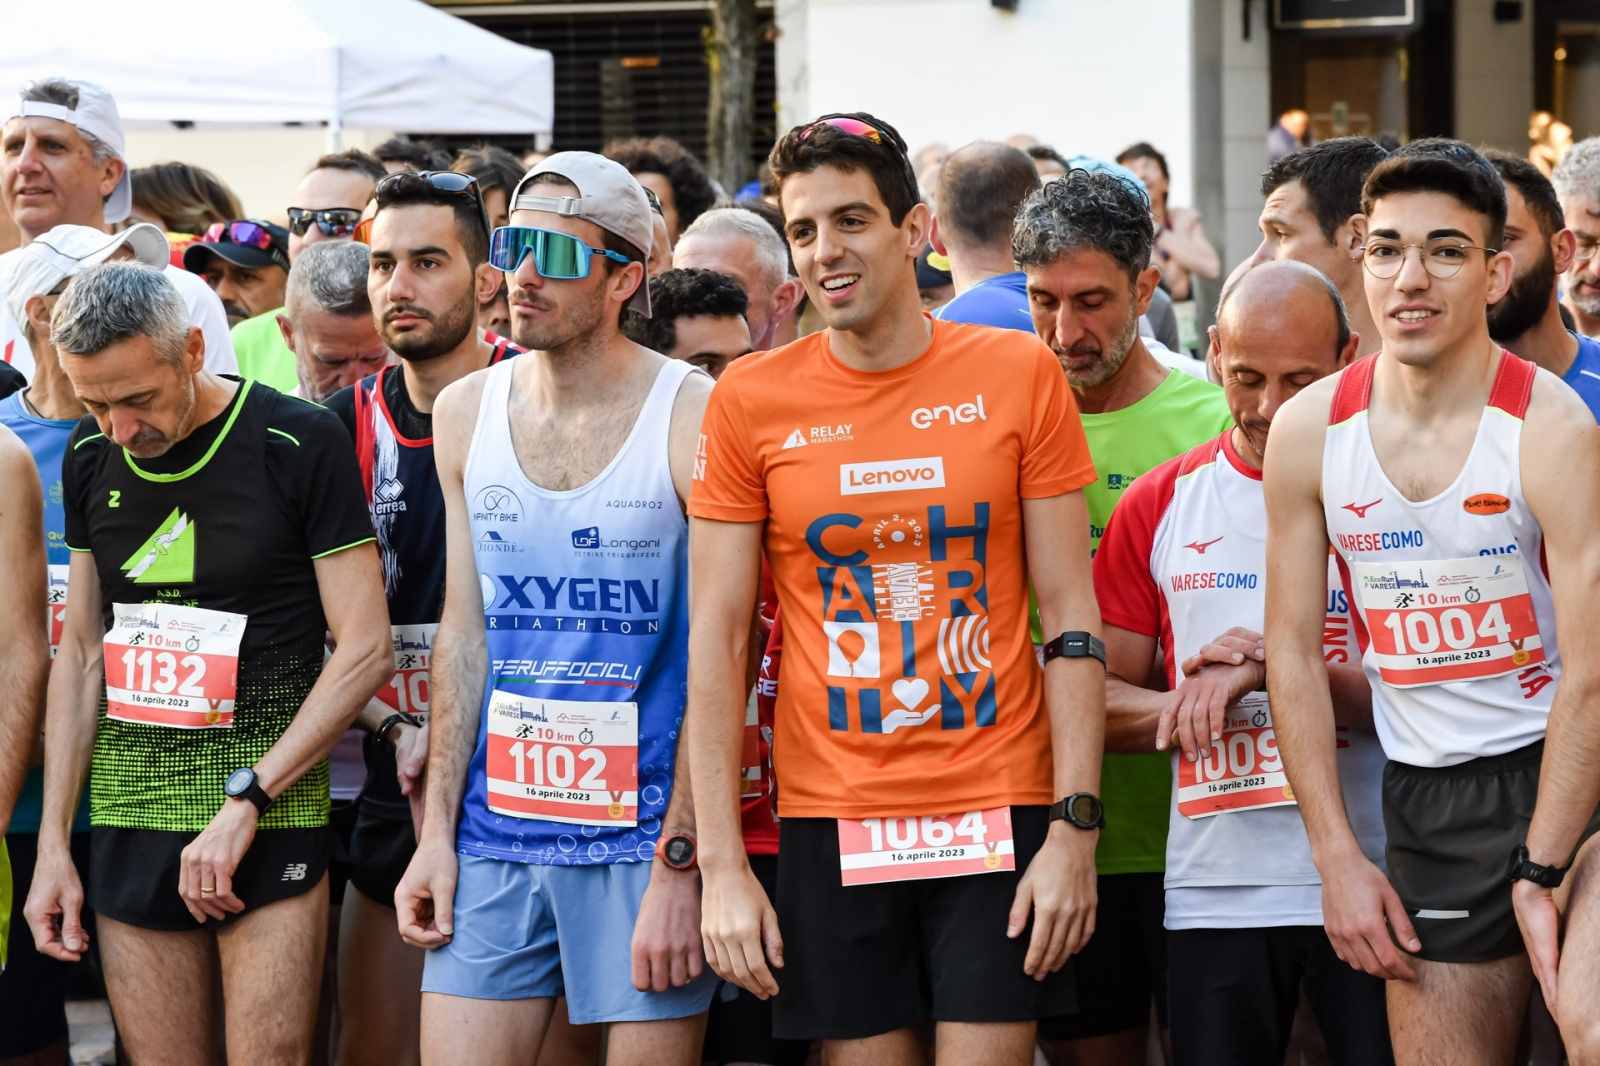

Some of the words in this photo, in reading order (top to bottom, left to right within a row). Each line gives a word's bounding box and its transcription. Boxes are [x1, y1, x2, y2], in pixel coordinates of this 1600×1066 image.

[911, 394, 987, 429] enel
[810, 424, 853, 438] RELAY
[810, 434, 854, 444] MARATHON
[849, 467, 935, 486] Lenovo
[376, 501, 407, 514] errea
[606, 500, 663, 509] AQUADRO2
[500, 513, 518, 522] BIKE
[873, 519, 889, 550] APRIL
[908, 519, 923, 547] 2023
[600, 538, 660, 550] Longoni
[1171, 572, 1258, 592] VARESECOMO
[157, 589, 182, 598] A.S.D.
[1418, 593, 1438, 606] 10
[1441, 594, 1461, 604] km
[489, 616, 658, 634] RIATHLON
[1384, 602, 1512, 655] 1004
[148, 634, 163, 646] 10
[165, 637, 182, 648] km
[1416, 656, 1429, 665] 16
[1432, 654, 1462, 666] aprile
[1464, 650, 1491, 660] 2023
[122, 648, 207, 698] 1132
[492, 659, 642, 681] PERUFFOCICLI
[389, 671, 430, 712] 10
[132, 694, 140, 702] 16
[141, 696, 166, 706] aprile
[168, 698, 190, 708] 2023
[498, 710, 520, 719] VARESE
[537, 728, 554, 740] 10
[557, 732, 574, 742] km
[1196, 729, 1284, 784] 1009
[508, 742, 607, 790] 1102
[1208, 784, 1217, 792] 16
[1218, 780, 1242, 792] aprile
[1244, 777, 1266, 788] 2023
[526, 788, 536, 796] 16
[538, 790, 564, 800] aprile
[566, 792, 590, 801] 2023
[861, 810, 988, 852] 1064
[891, 853, 904, 861] 16
[906, 850, 936, 862] aprile
[938, 848, 965, 858] 2023
